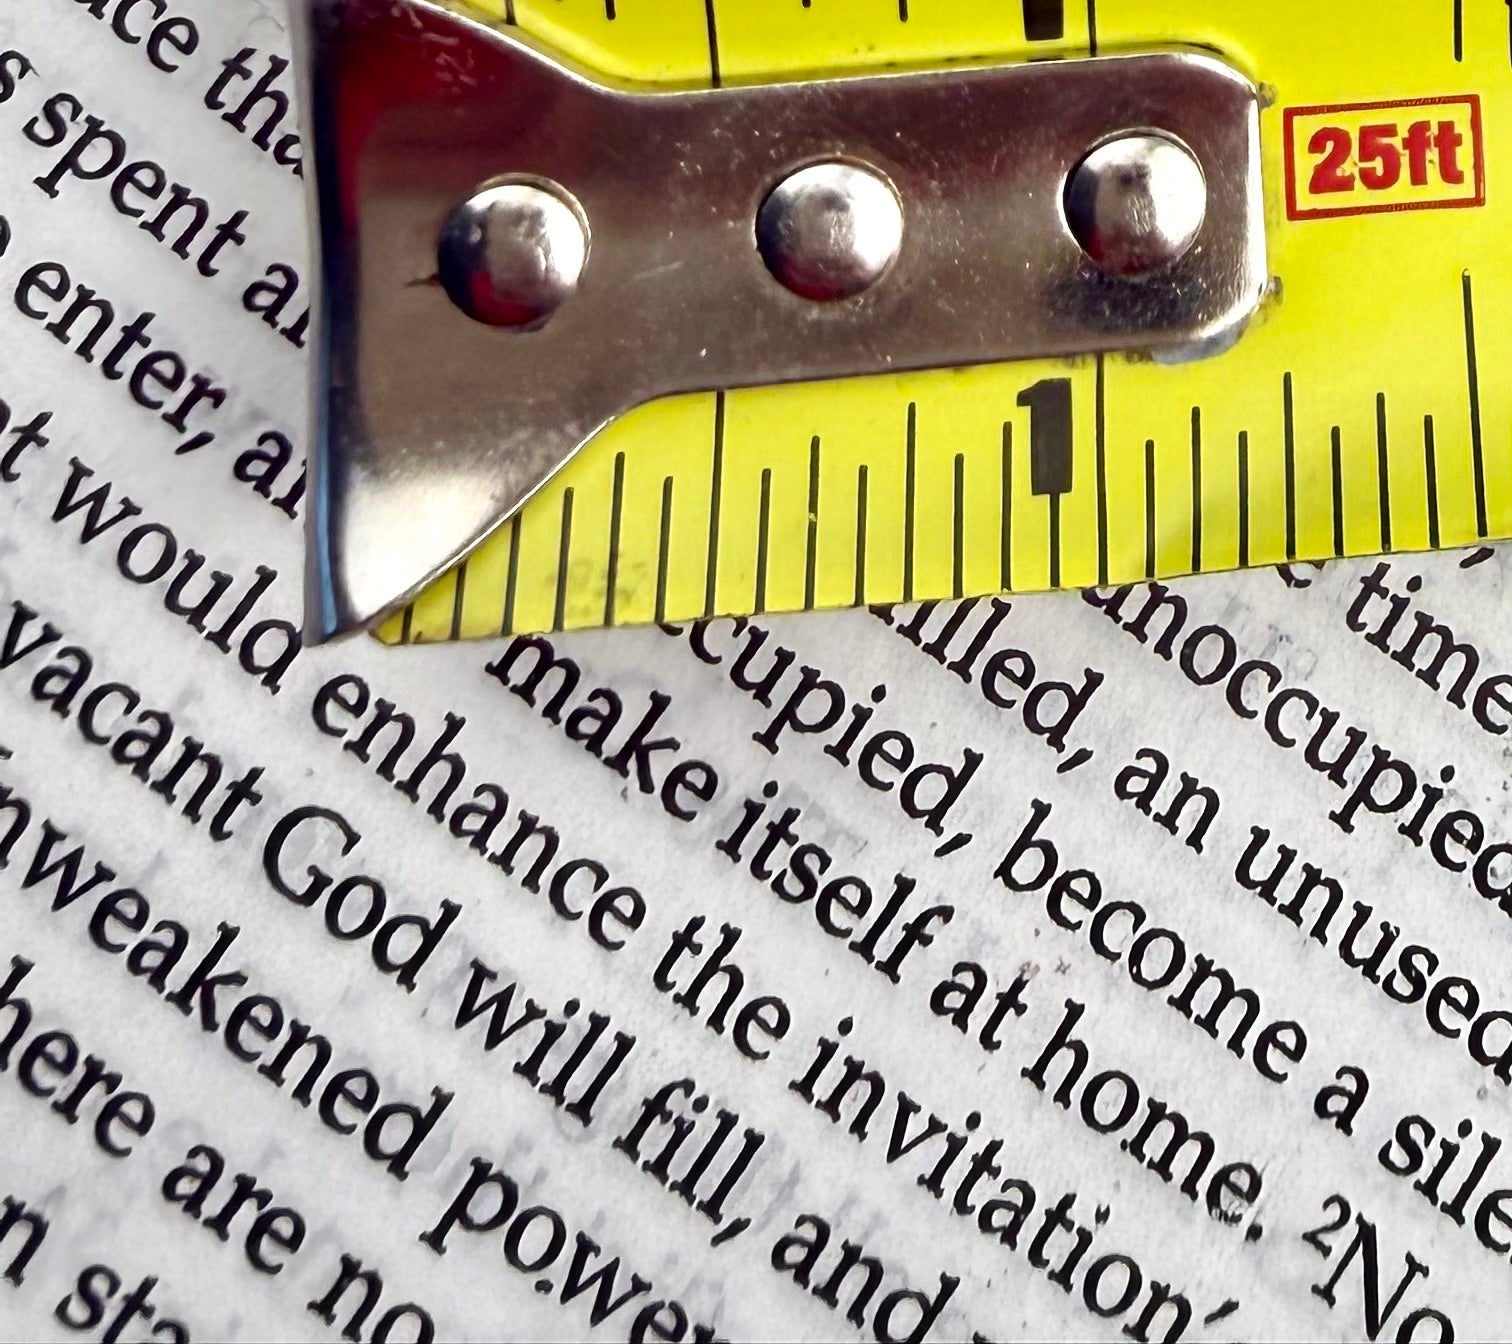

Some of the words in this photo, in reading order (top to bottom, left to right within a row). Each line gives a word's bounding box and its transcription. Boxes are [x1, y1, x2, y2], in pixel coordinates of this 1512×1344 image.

[22, 93, 248, 277] spent
[1308, 121, 1463, 194] 25ft
[14, 262, 226, 455] enter,
[1017, 378, 1073, 495] 1
[312, 675, 646, 951] enhance
[653, 916, 790, 1061] the
[485, 633, 718, 822] make
[715, 781, 954, 985] itself
[930, 962, 1029, 1053] at
[1114, 748, 1219, 854] an
[263, 806, 462, 993] God
[455, 958, 636, 1128] will
[612, 1078, 765, 1247] fill,
[993, 799, 1307, 1084] become
[1314, 1066, 1369, 1136] a
[162, 1145, 305, 1275] are
